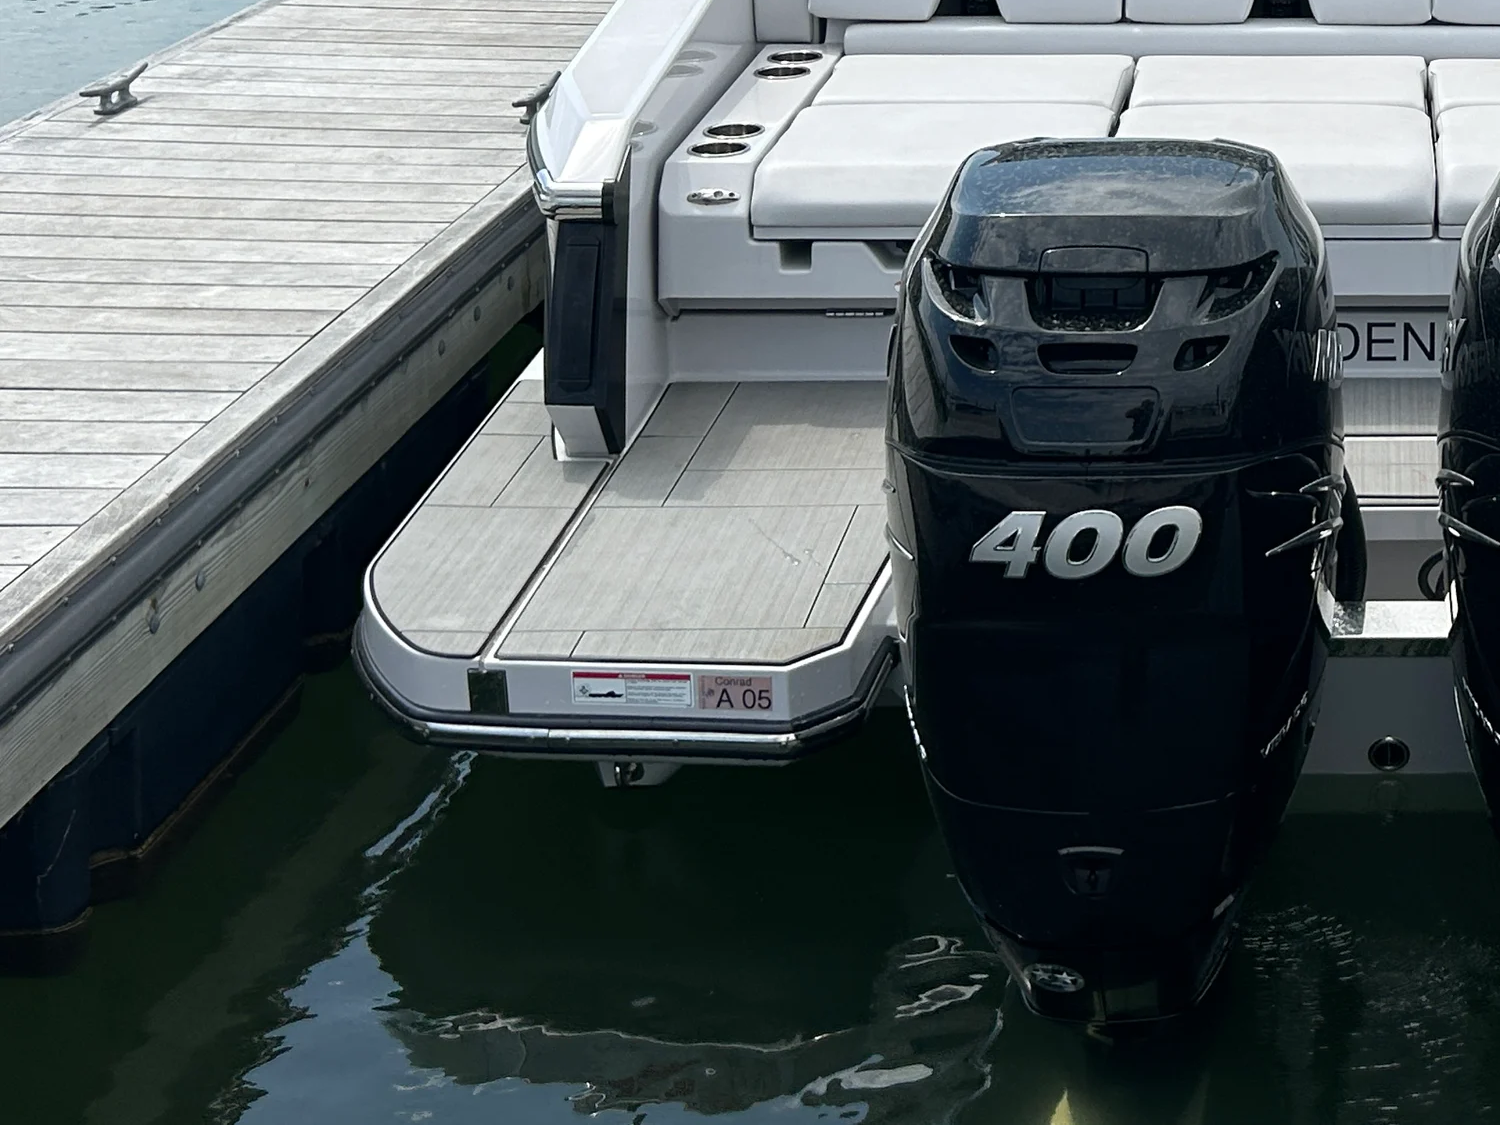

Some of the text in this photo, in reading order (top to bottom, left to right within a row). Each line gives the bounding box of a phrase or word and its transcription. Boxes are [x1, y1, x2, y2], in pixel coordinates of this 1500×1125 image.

[969, 505, 1203, 579] 400
[715, 676, 752, 687] Conrad
[716, 687, 734, 709] A
[742, 688, 772, 710] 05
